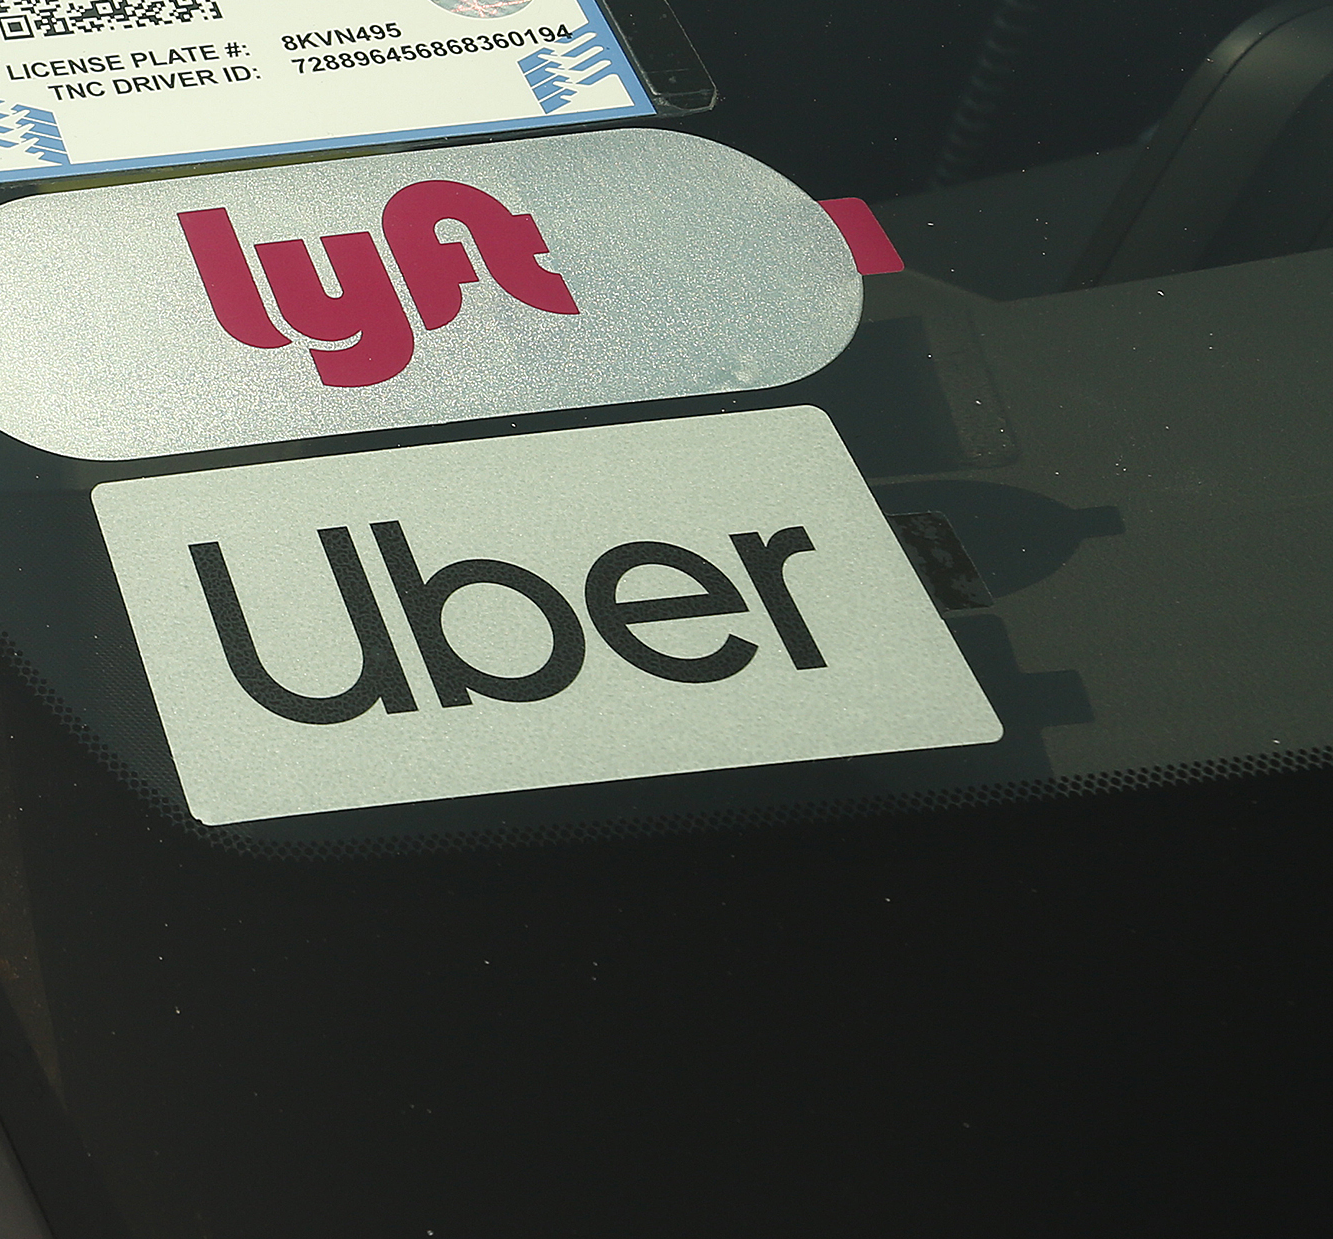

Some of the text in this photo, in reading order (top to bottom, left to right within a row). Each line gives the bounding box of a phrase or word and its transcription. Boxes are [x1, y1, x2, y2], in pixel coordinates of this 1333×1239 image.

[281, 22, 402, 51] 8KVN495
[290, 23, 574, 74] 728896456868360194
[6, 41, 251, 81] LICENSE PLATE #:
[47, 65, 262, 101] TNC DRIVER ID:
[178, 180, 579, 388] lyft
[188, 520, 827, 725] Uber
